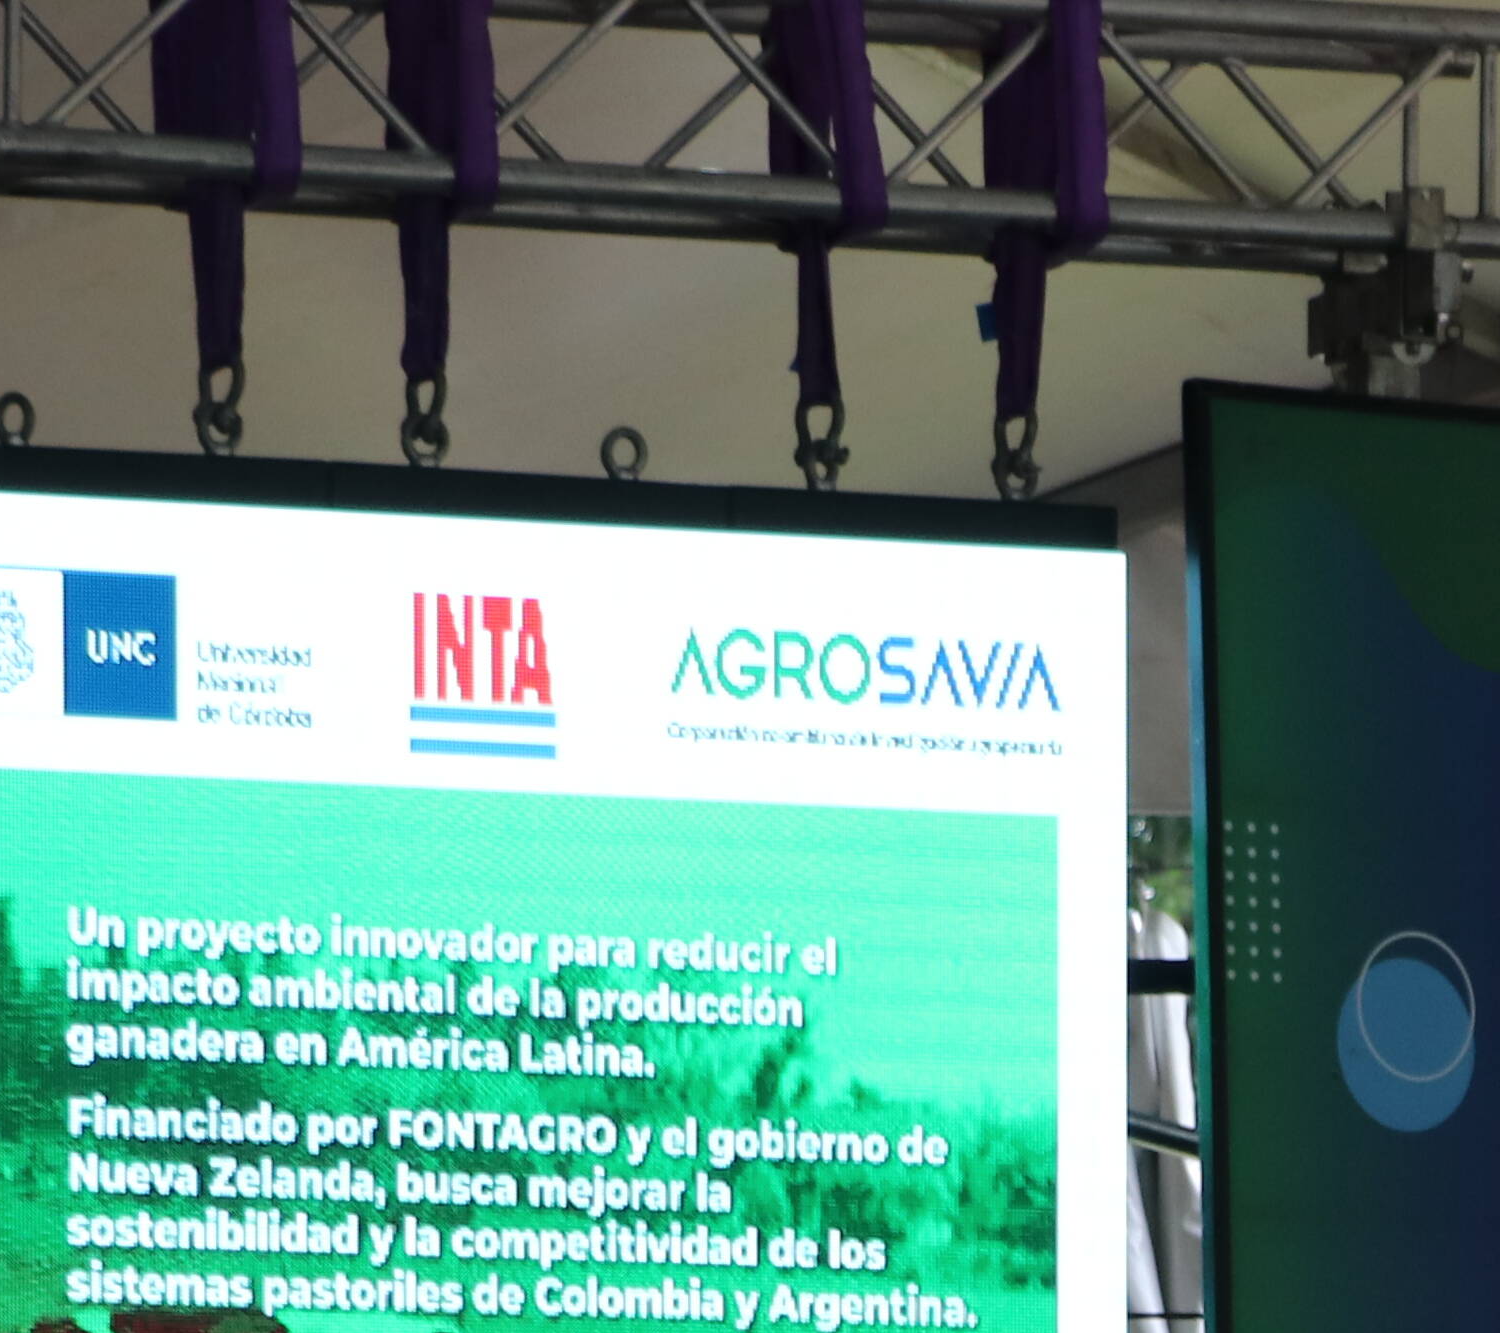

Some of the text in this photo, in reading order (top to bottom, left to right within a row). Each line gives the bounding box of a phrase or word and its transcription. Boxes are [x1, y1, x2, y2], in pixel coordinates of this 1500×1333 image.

[86, 629, 157, 668] UNC
[410, 591, 554, 707] INTA
[670, 628, 1062, 711] AGROSAVIA
[67, 907, 837, 976] Un proyecto innovador para reducir el
[67, 958, 803, 1029] impacto ambiental de la producción
[66, 1018, 655, 1078] ganadera en América Latina.
[69, 1099, 949, 1168] Financiado por FONTAGRO y el gobierno de
[69, 1156, 731, 1219] Nueva Zelanda, busca mejorar la
[66, 1211, 885, 1272] sostenibilidad y la competitividad de los
[66, 1262, 979, 1333] sistemas pastoriles de Colombia y Argentina.
